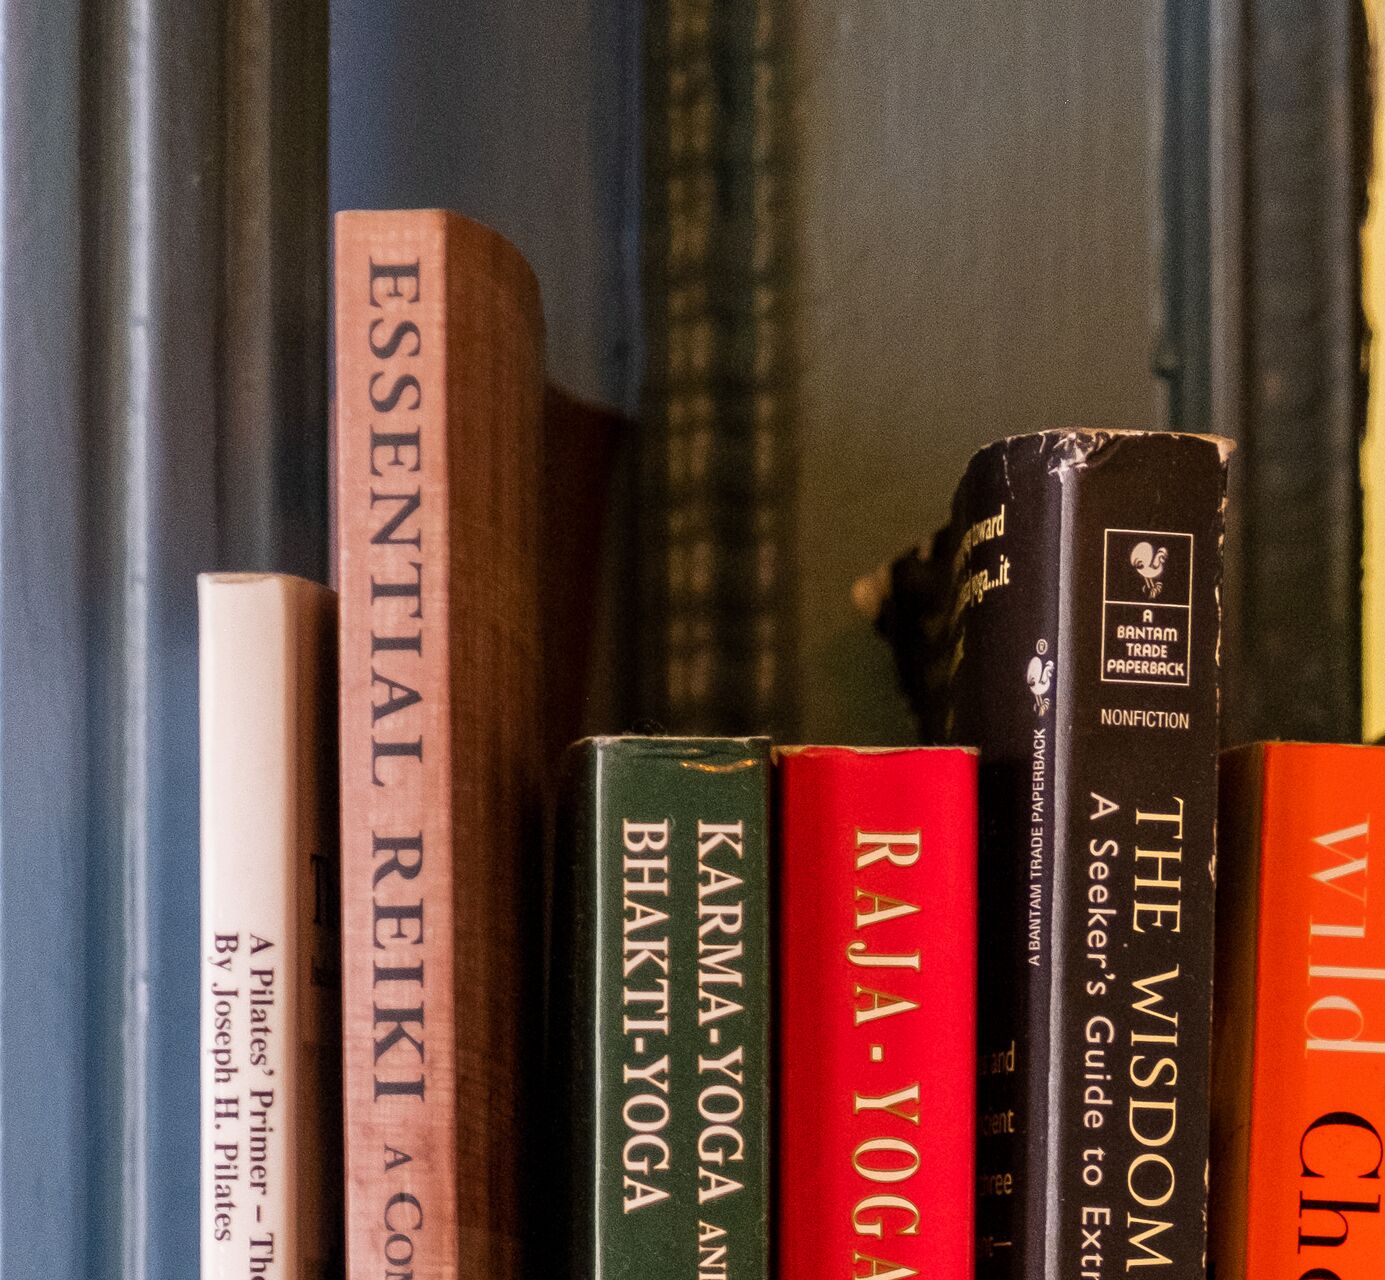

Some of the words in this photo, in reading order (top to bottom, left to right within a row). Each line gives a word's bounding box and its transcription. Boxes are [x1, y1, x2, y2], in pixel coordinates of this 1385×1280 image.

[369, 258, 423, 786] ESSENTIAL
[1118, 626, 1177, 641] BANTAM
[1143, 609, 1153, 622] A
[1106, 659, 1185, 678] PAPERBACK
[1127, 643, 1166, 657] TRADE
[1101, 709, 1189, 729] NONFICTION
[1032, 728, 1045, 822] PAPERBACK
[1090, 792, 1119, 820] A
[1031, 827, 1043, 879] TRADE
[1133, 797, 1184, 932] THE
[251, 935, 274, 954] A
[1029, 884, 1041, 950] BANTAM
[209, 933, 239, 970] By
[373, 831, 426, 1102] REIKI
[1028, 949, 1041, 967] A
[212, 983, 239, 1083] Joseph
[623, 819, 669, 1213] BHAKTI-YOGA
[698, 820, 743, 1203] KARMA-YOGA
[1084, 1016, 1114, 1128] Guide
[215, 1098, 239, 1129] H.
[251, 1090, 274, 1195] Primer
[1126, 964, 1179, 1271] WISDOM
[215, 1144, 238, 1241] Pilates
[1083, 1148, 1105, 1186] to
